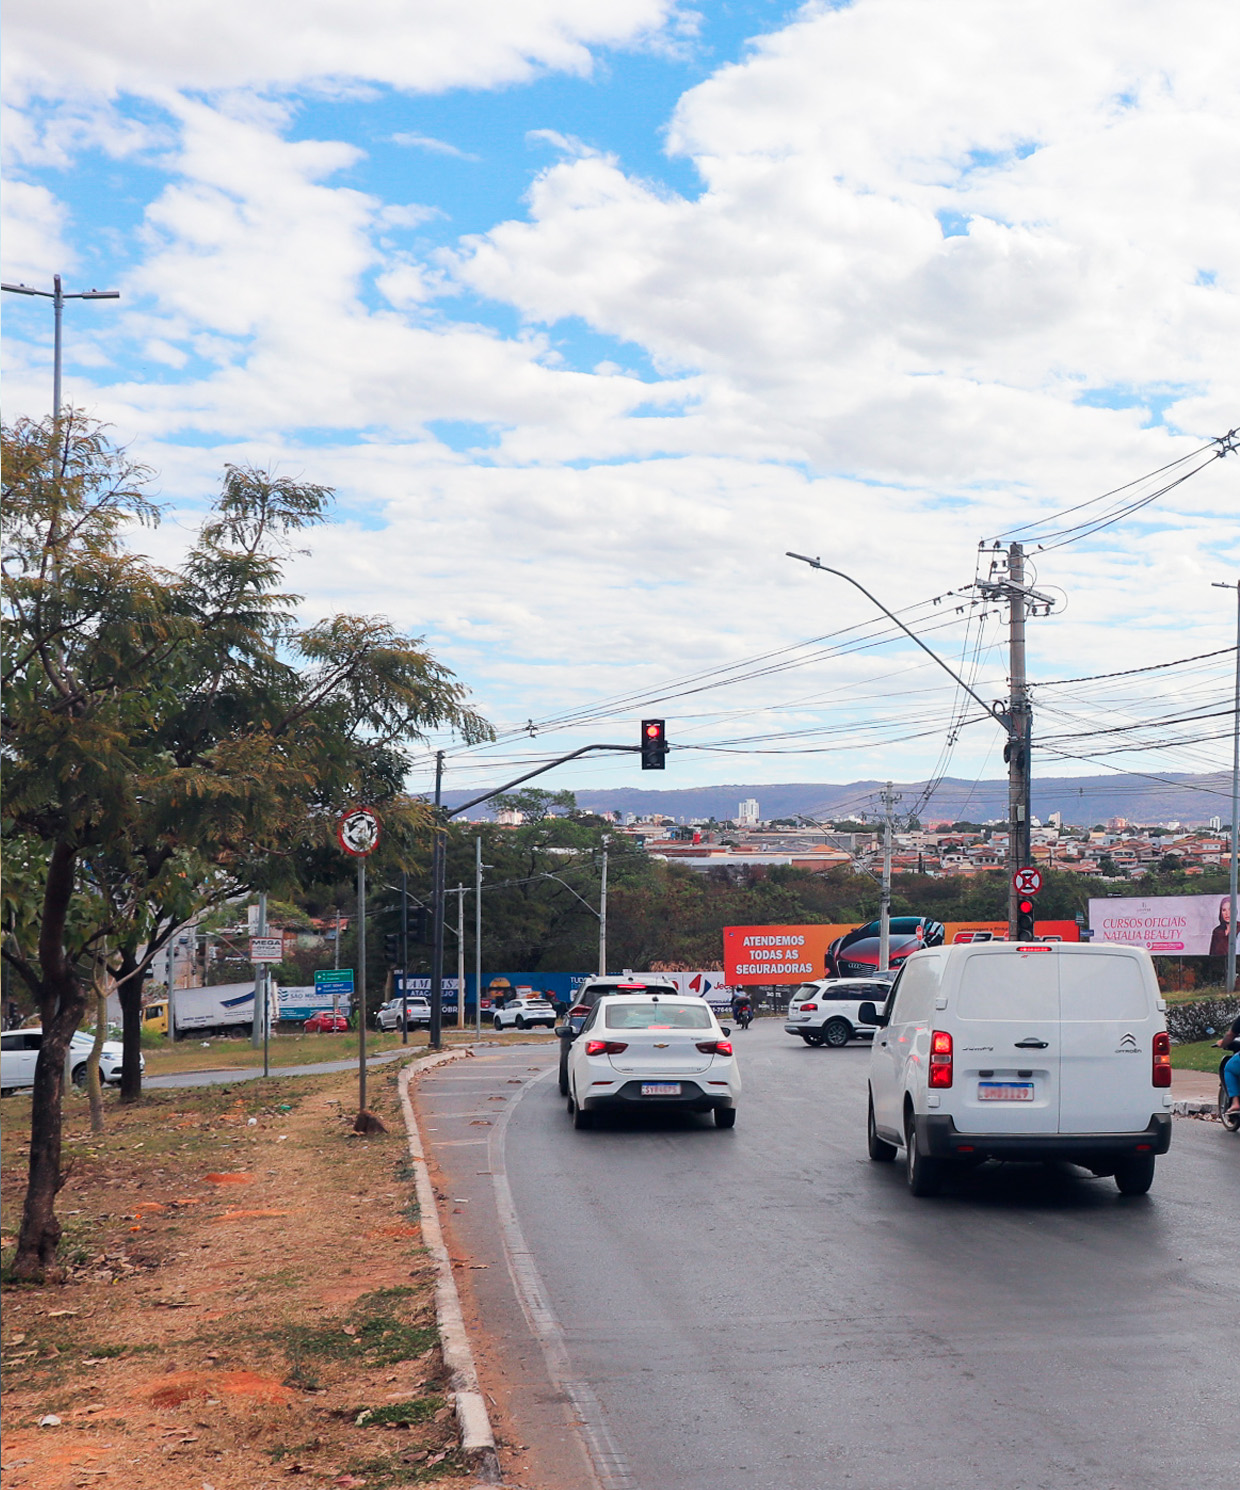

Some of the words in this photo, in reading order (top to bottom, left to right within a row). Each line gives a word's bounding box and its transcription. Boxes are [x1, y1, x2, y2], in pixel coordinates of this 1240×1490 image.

[1102, 918, 1143, 929] CURSOS
[1144, 916, 1187, 928] OFICIAIS
[1103, 931, 1142, 940] NATALIA
[1144, 929, 1183, 940] BEAUTY
[743, 935, 806, 947] ATENDEMOS
[749, 949, 783, 960] TODAS
[785, 949, 799, 960] AS
[735, 963, 814, 975] SEGURADORAS
